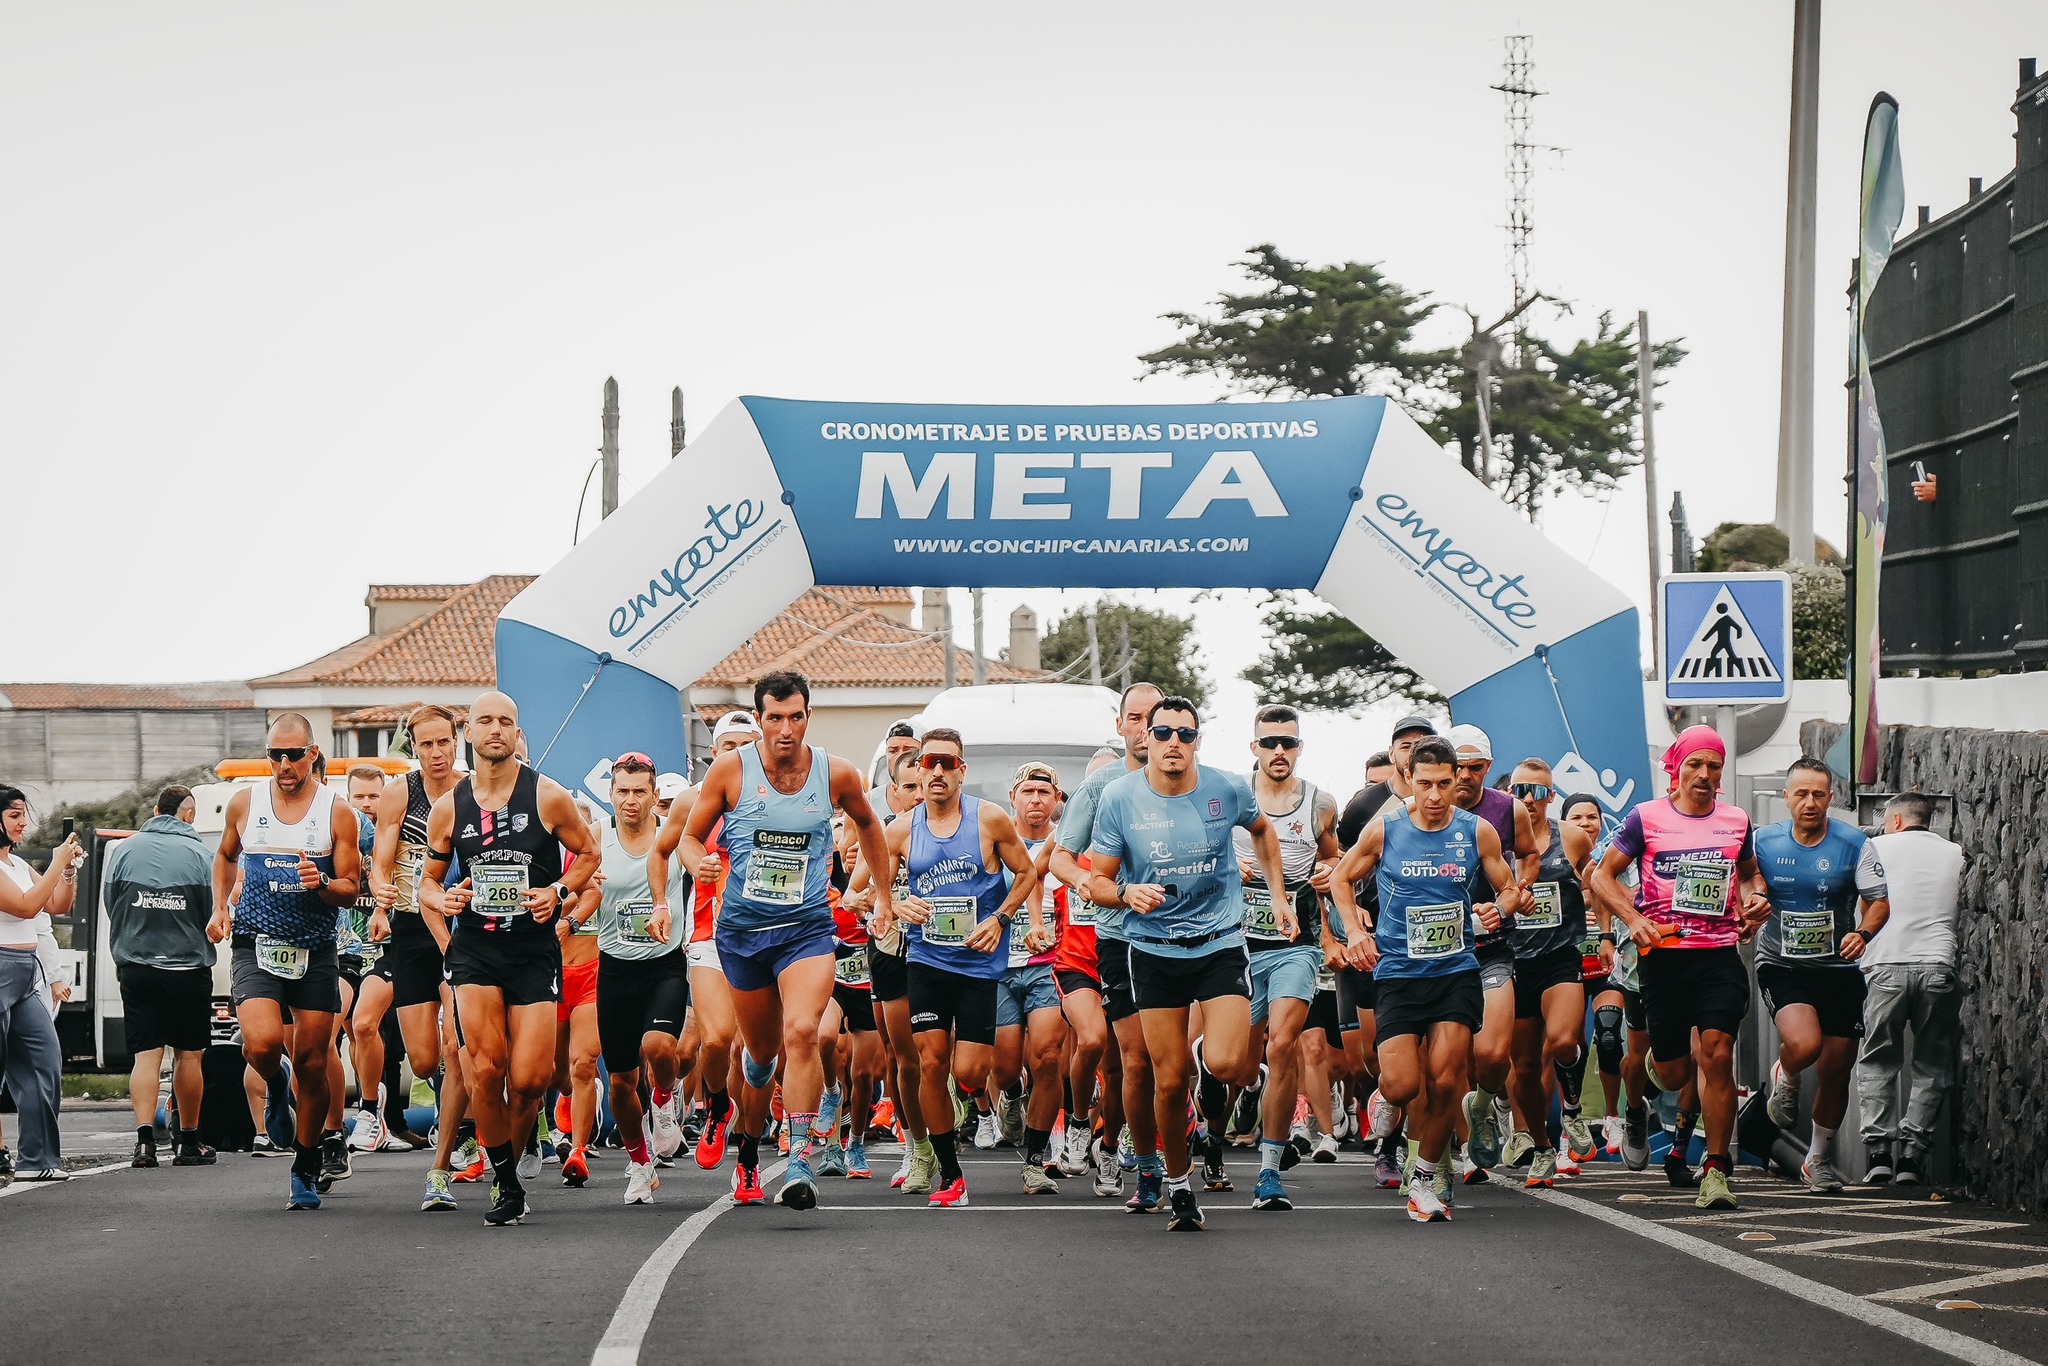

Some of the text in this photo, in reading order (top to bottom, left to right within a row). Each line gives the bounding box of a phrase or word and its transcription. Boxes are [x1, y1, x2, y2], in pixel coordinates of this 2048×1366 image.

[820, 420, 1319, 442] CRONOMETRAJE DE PRUEBAS DEPORTIVAS
[854, 450, 1290, 520] META
[893, 538, 1249, 554] WWW.CONCHIPCANARIAS.COM
[608, 498, 764, 638] empate
[1376, 493, 1537, 629] empate
[631, 523, 789, 658] DEPORTES TIENDA VAQUERA
[1355, 518, 1514, 655] DEPORTES TIENDA VAQUERA
[758, 831, 806, 845] Genacol
[466, 849, 532, 867] OLYMPUS
[1680, 850, 1722, 862] MEDIO
[929, 859, 965, 877] CANARY
[1401, 863, 1467, 878] OUTDOOR
[770, 873, 788, 888] 11
[933, 872, 969, 887] RUNNER
[488, 887, 518, 901] 268
[1693, 883, 1720, 899] 105
[948, 917, 956, 931] 1
[1426, 924, 1456, 942] 270
[1797, 931, 1826, 945] 222
[271, 950, 297, 964] 101
[840, 960, 863, 974] 181
